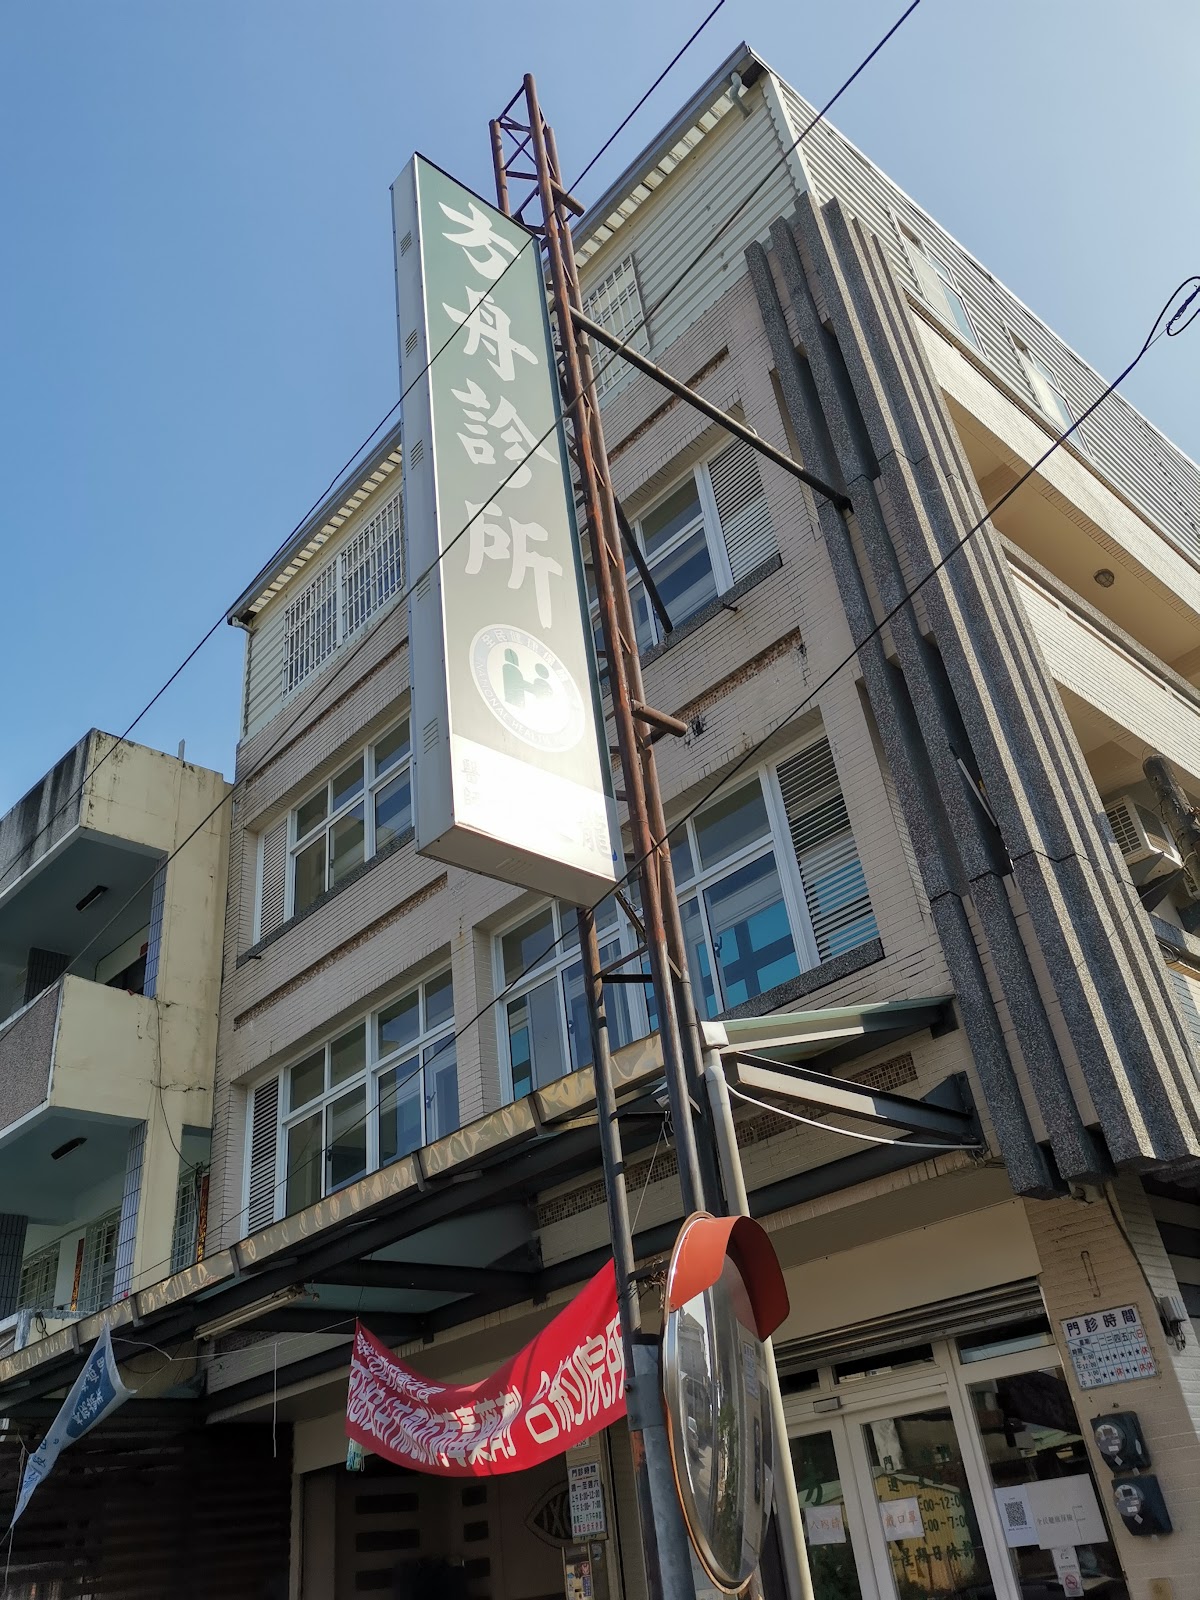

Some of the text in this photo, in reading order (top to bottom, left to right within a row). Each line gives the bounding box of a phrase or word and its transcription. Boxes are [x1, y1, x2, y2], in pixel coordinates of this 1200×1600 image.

[438, 201, 563, 629] 方舟診所
[1066, 1308, 1137, 1337] 門診時間
[571, 1465, 597, 1477] 門診時間
[884, 1510, 919, 1528] 戴口罩
